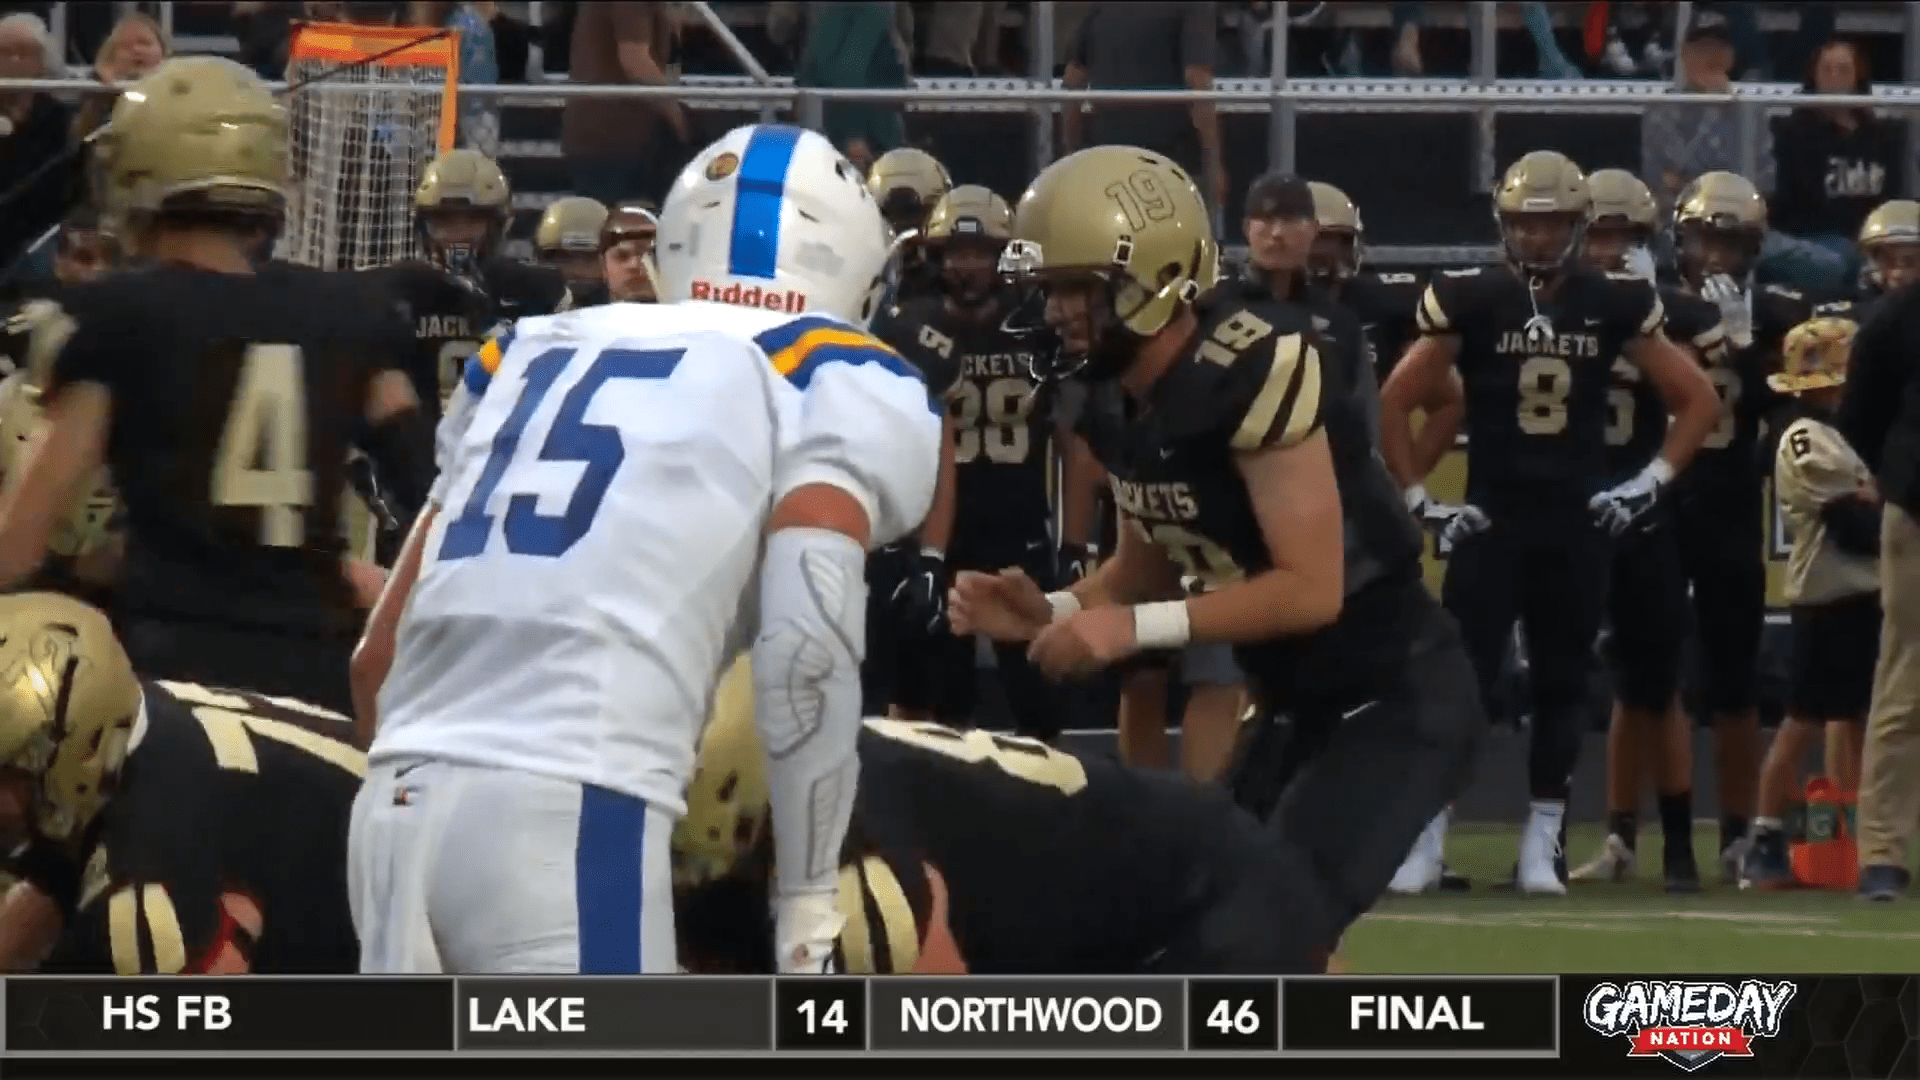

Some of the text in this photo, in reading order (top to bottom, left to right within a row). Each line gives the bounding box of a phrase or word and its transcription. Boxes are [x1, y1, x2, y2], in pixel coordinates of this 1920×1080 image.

[1104, 169, 1176, 233] 19
[691, 279, 806, 314] Riddell
[1517, 356, 1571, 435] 8
[211, 343, 314, 547] 4
[437, 347, 687, 559] 15
